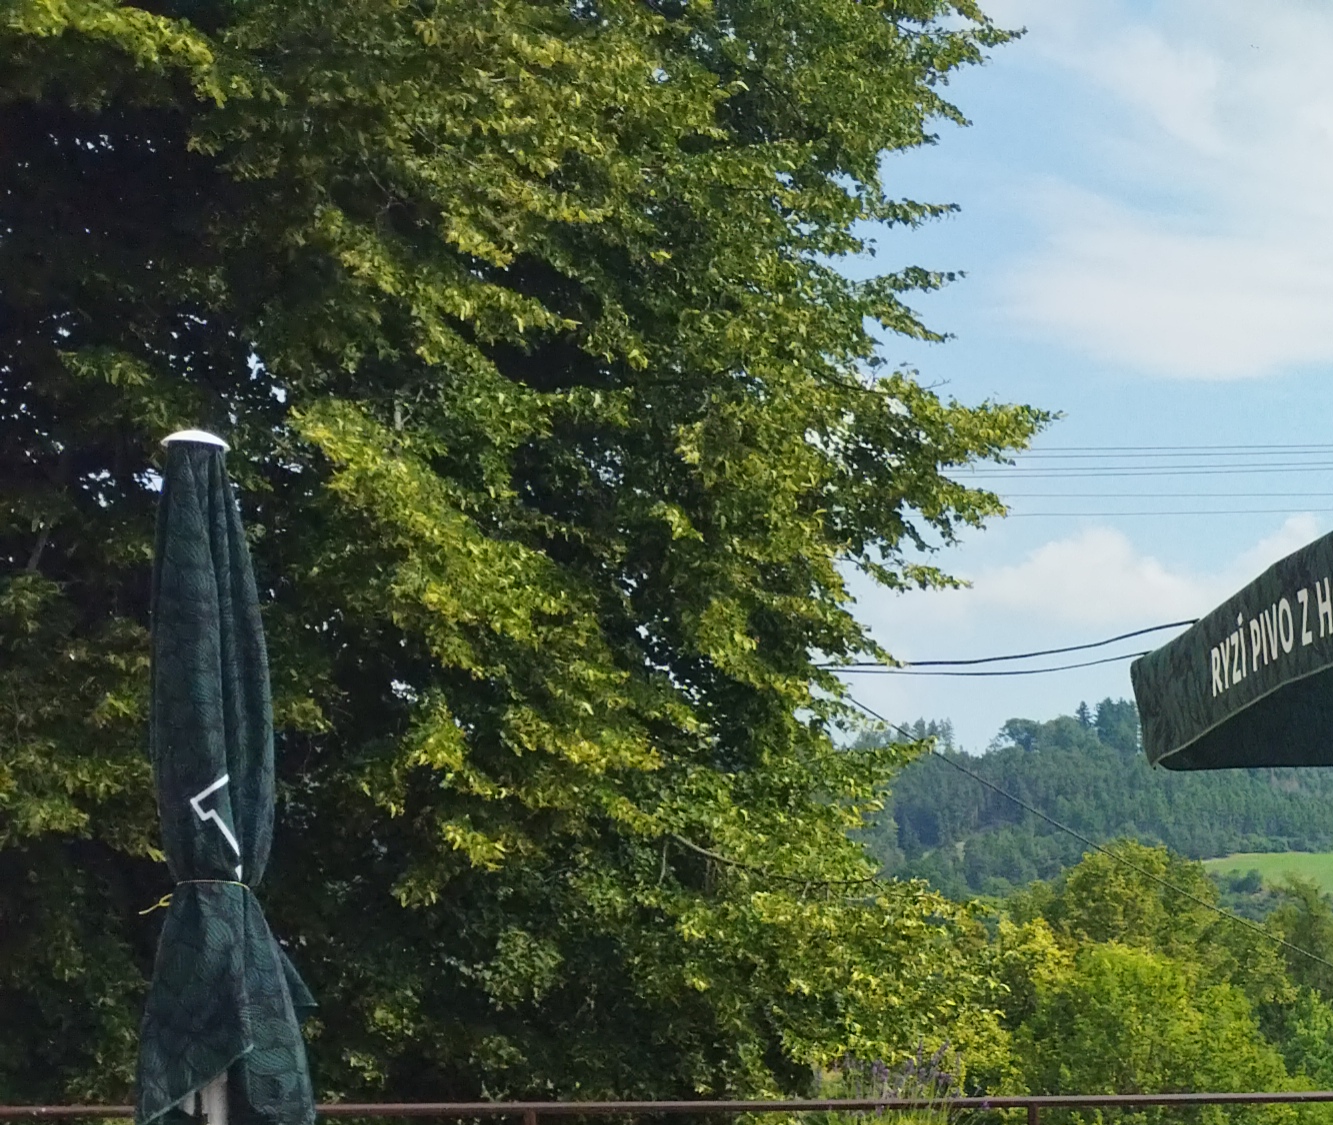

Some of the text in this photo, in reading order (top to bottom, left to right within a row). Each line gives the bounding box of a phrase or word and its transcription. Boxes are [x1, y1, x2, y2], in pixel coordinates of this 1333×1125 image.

[1211, 612, 1246, 698] RYZÍ
[1250, 598, 1294, 672] PIVO
[1297, 588, 1312, 646] Z
